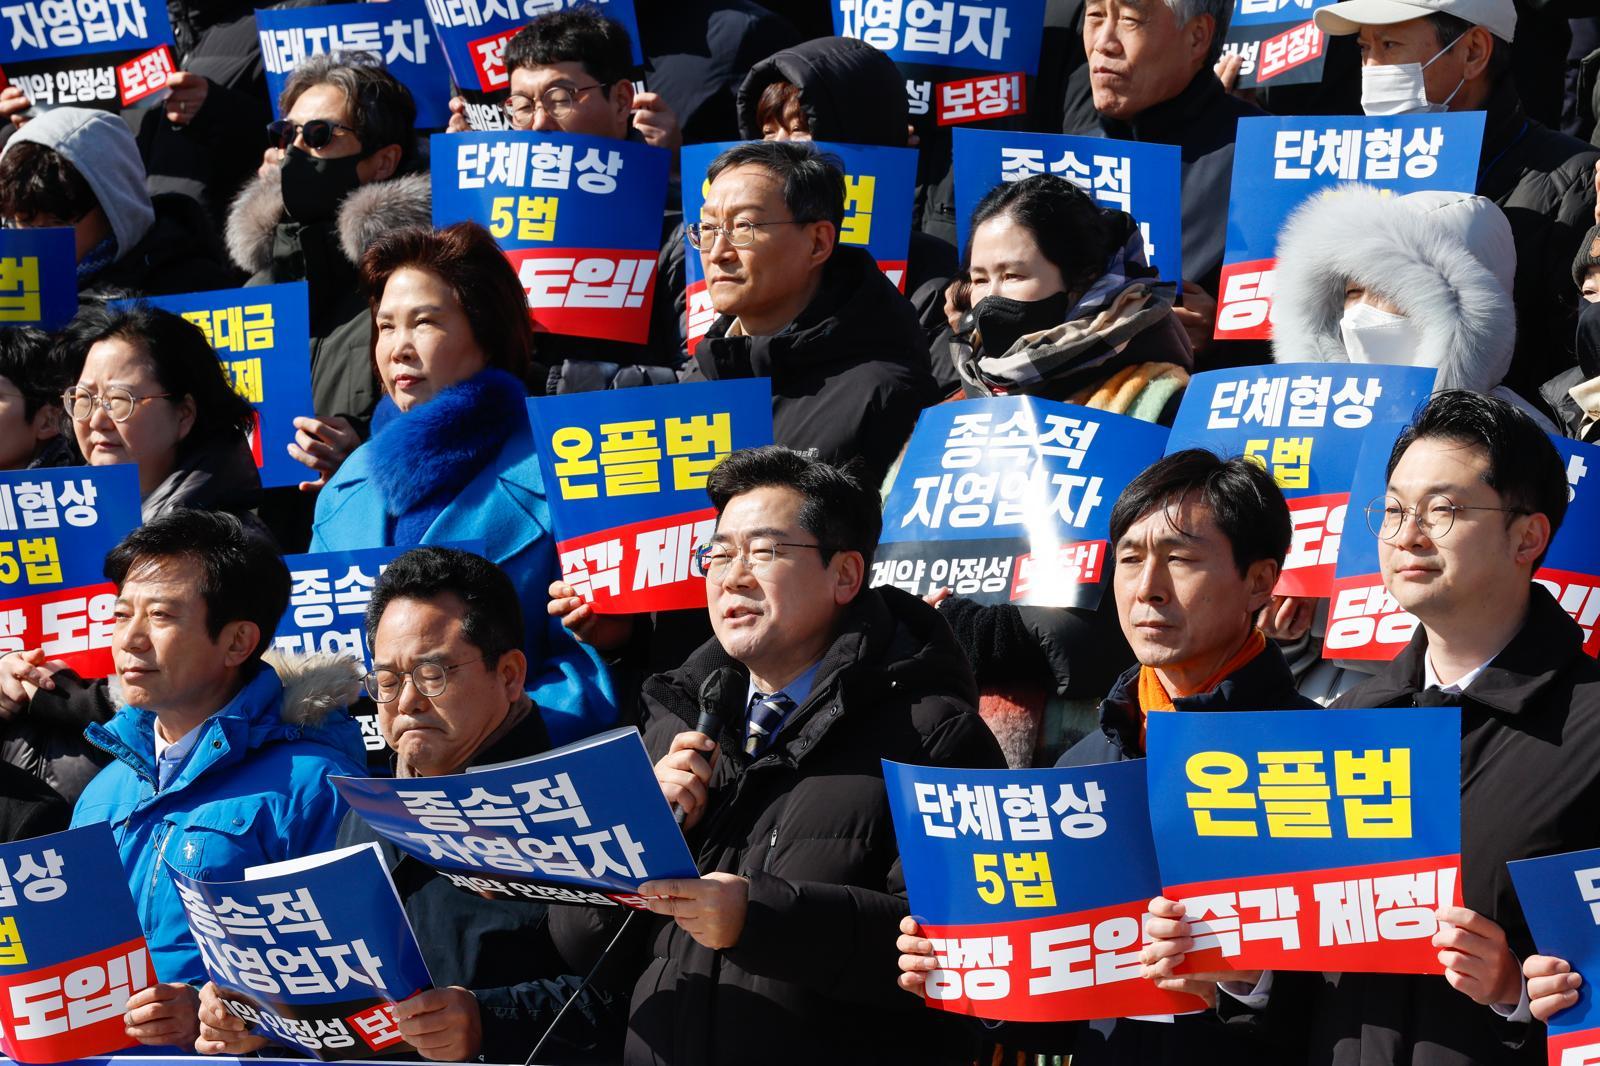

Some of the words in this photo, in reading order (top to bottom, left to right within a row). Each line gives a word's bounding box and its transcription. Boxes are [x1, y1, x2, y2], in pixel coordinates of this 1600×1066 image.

[1, 0, 148, 50] 자영업자
[840, 0, 1011, 60] 자영업자
[1261, 23, 1321, 76] 보장!
[56, 66, 117, 103] 안정성
[121, 48, 171, 100] 보장!
[942, 76, 1020, 120] 보장!
[457, 142, 623, 194] 단체협상
[1274, 127, 1444, 180] 단체협상
[489, 195, 558, 241] 5법
[518, 257, 656, 309] 도입!
[1207, 376, 1382, 429] 단체협상
[552, 412, 732, 500] 온플법
[941, 413, 1100, 470] 종속적
[560, 538, 623, 603] 즉각
[869, 559, 926, 596] 계약
[928, 556, 1012, 595] 안정성
[396, 772, 592, 834] 종속적
[914, 781, 1107, 842] 단체협상
[1185, 748, 1412, 838] 온플법
[404, 823, 649, 879] 자영업자
[508, 882, 619, 906] 안정성
[973, 851, 1057, 908] 5법
[174, 879, 332, 945] 종속적
[1178, 886, 1301, 957] 즉각
[189, 924, 387, 995] 자영업자
[925, 936, 1013, 1000] 당장
[9, 947, 147, 1041] 도입!
[259, 1012, 355, 1050] 안정성
